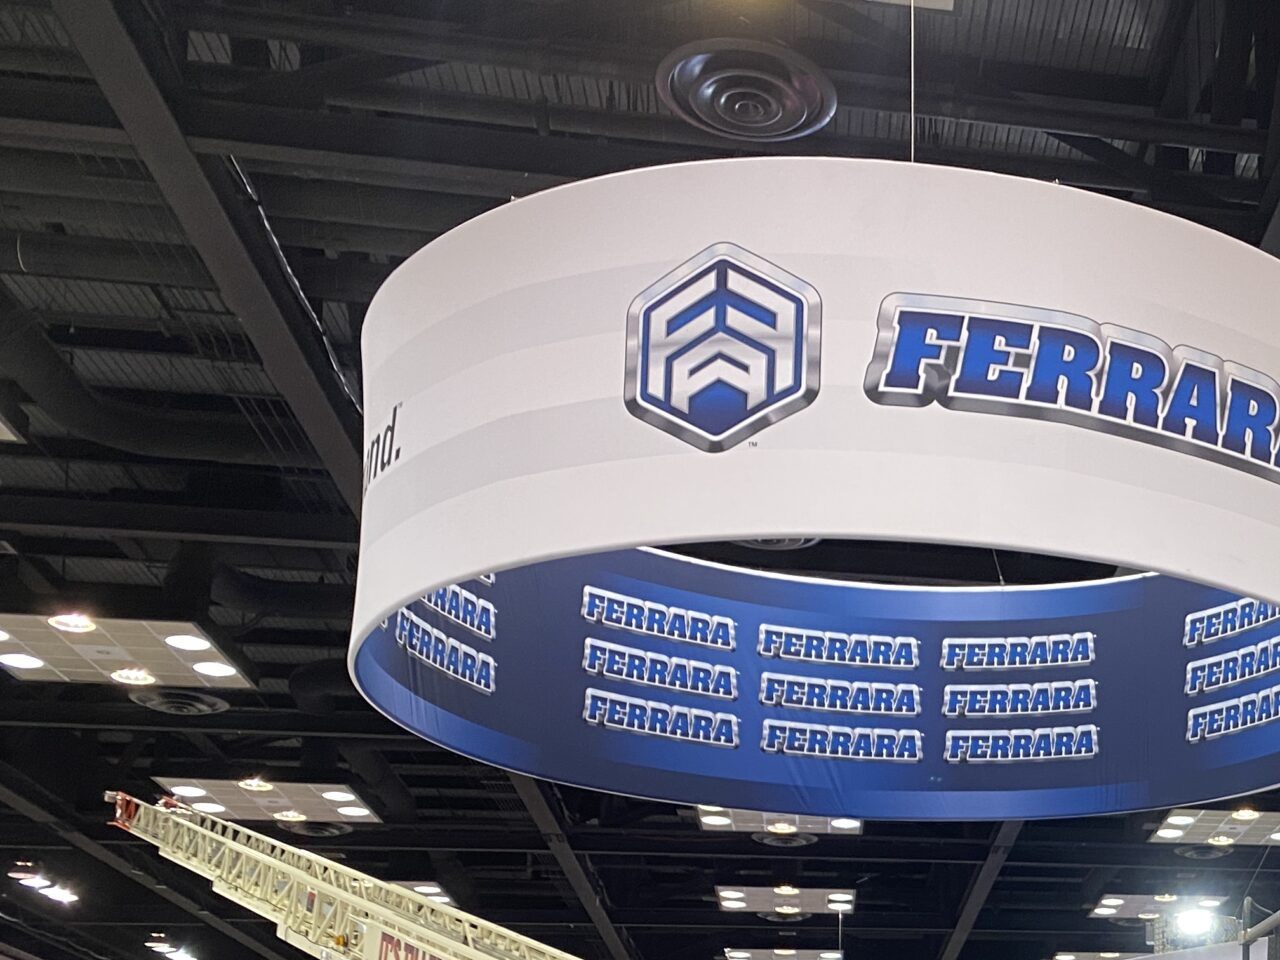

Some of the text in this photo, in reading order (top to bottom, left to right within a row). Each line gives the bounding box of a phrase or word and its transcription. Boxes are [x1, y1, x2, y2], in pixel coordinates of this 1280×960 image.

[582, 585, 735, 651] FERRARA
[396, 607, 495, 692] FERRARA
[758, 624, 918, 669] FERRARA
[941, 632, 1095, 669] FERRARA
[583, 638, 738, 700] FERRARA
[759, 672, 921, 716] FERRARA
[942, 678, 1097, 716] FERRARA
[584, 688, 740, 747] FERRARA
[761, 719, 923, 762] FERRARA
[945, 724, 1098, 762] FERRARA
